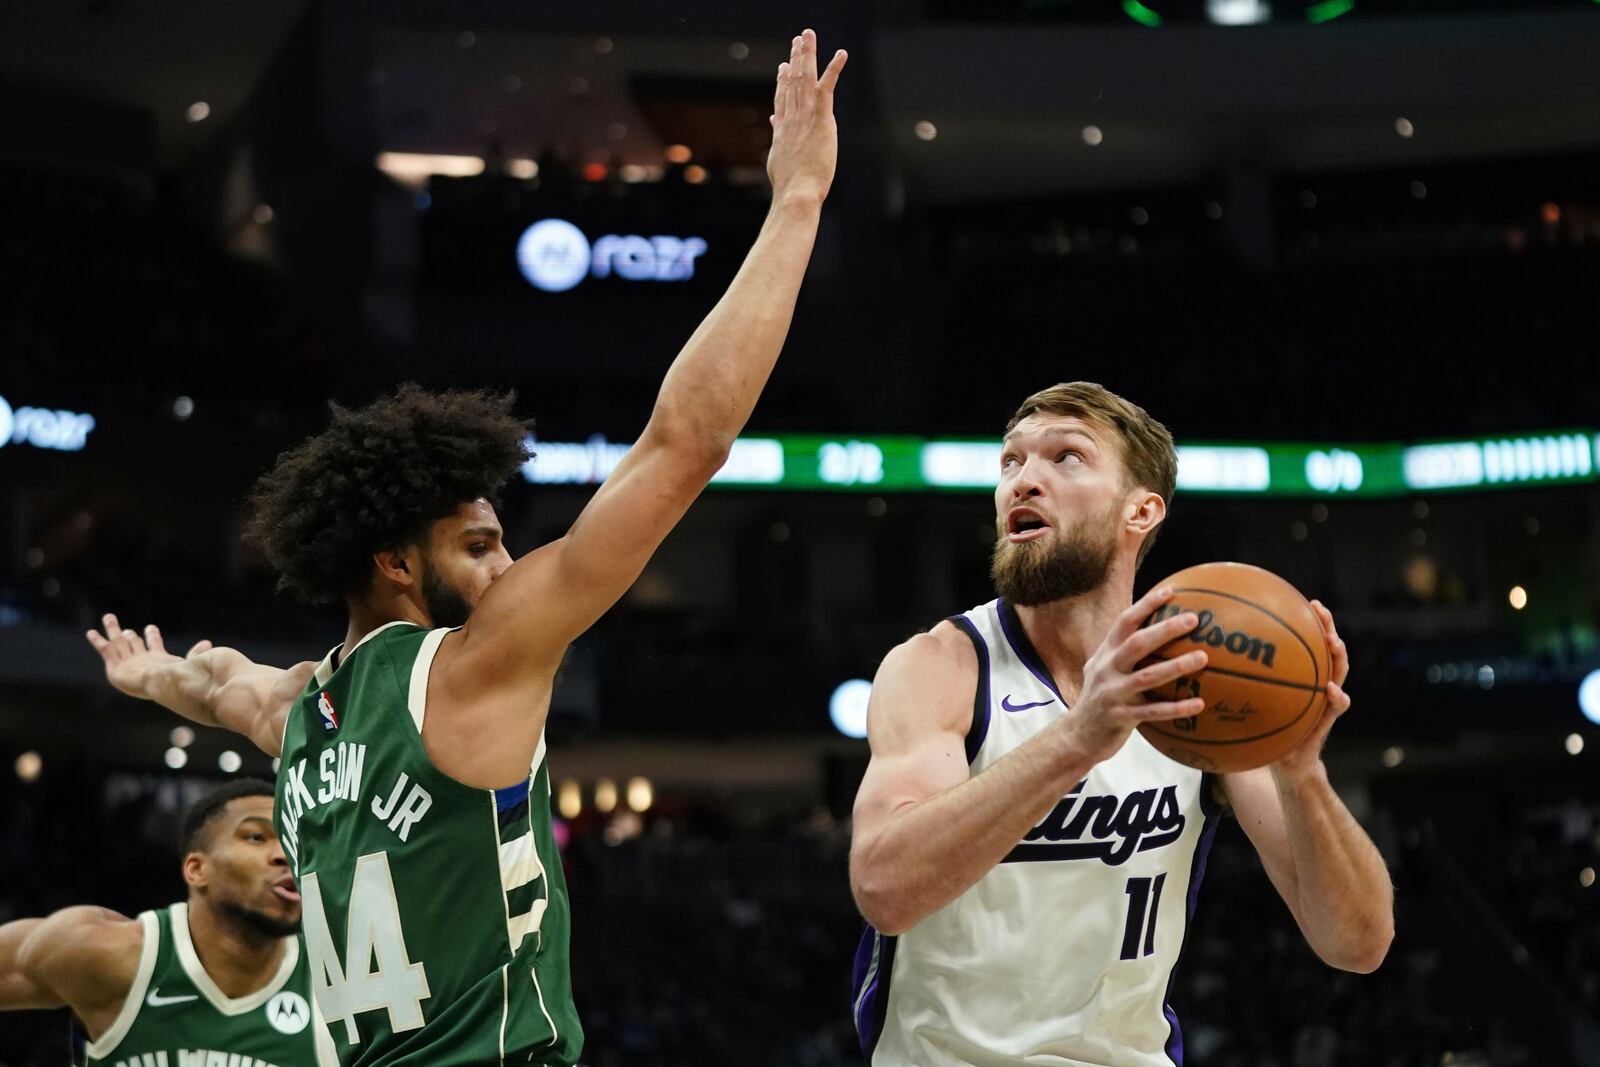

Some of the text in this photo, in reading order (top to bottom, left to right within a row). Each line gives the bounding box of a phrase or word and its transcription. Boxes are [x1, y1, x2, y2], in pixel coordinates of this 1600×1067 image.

[591, 234, 708, 282] razr
[13, 406, 96, 451] razr
[371, 771, 433, 843] JR
[1022, 778, 1186, 866] ings
[300, 850, 431, 1045] 44
[1119, 871, 1168, 961] 11
